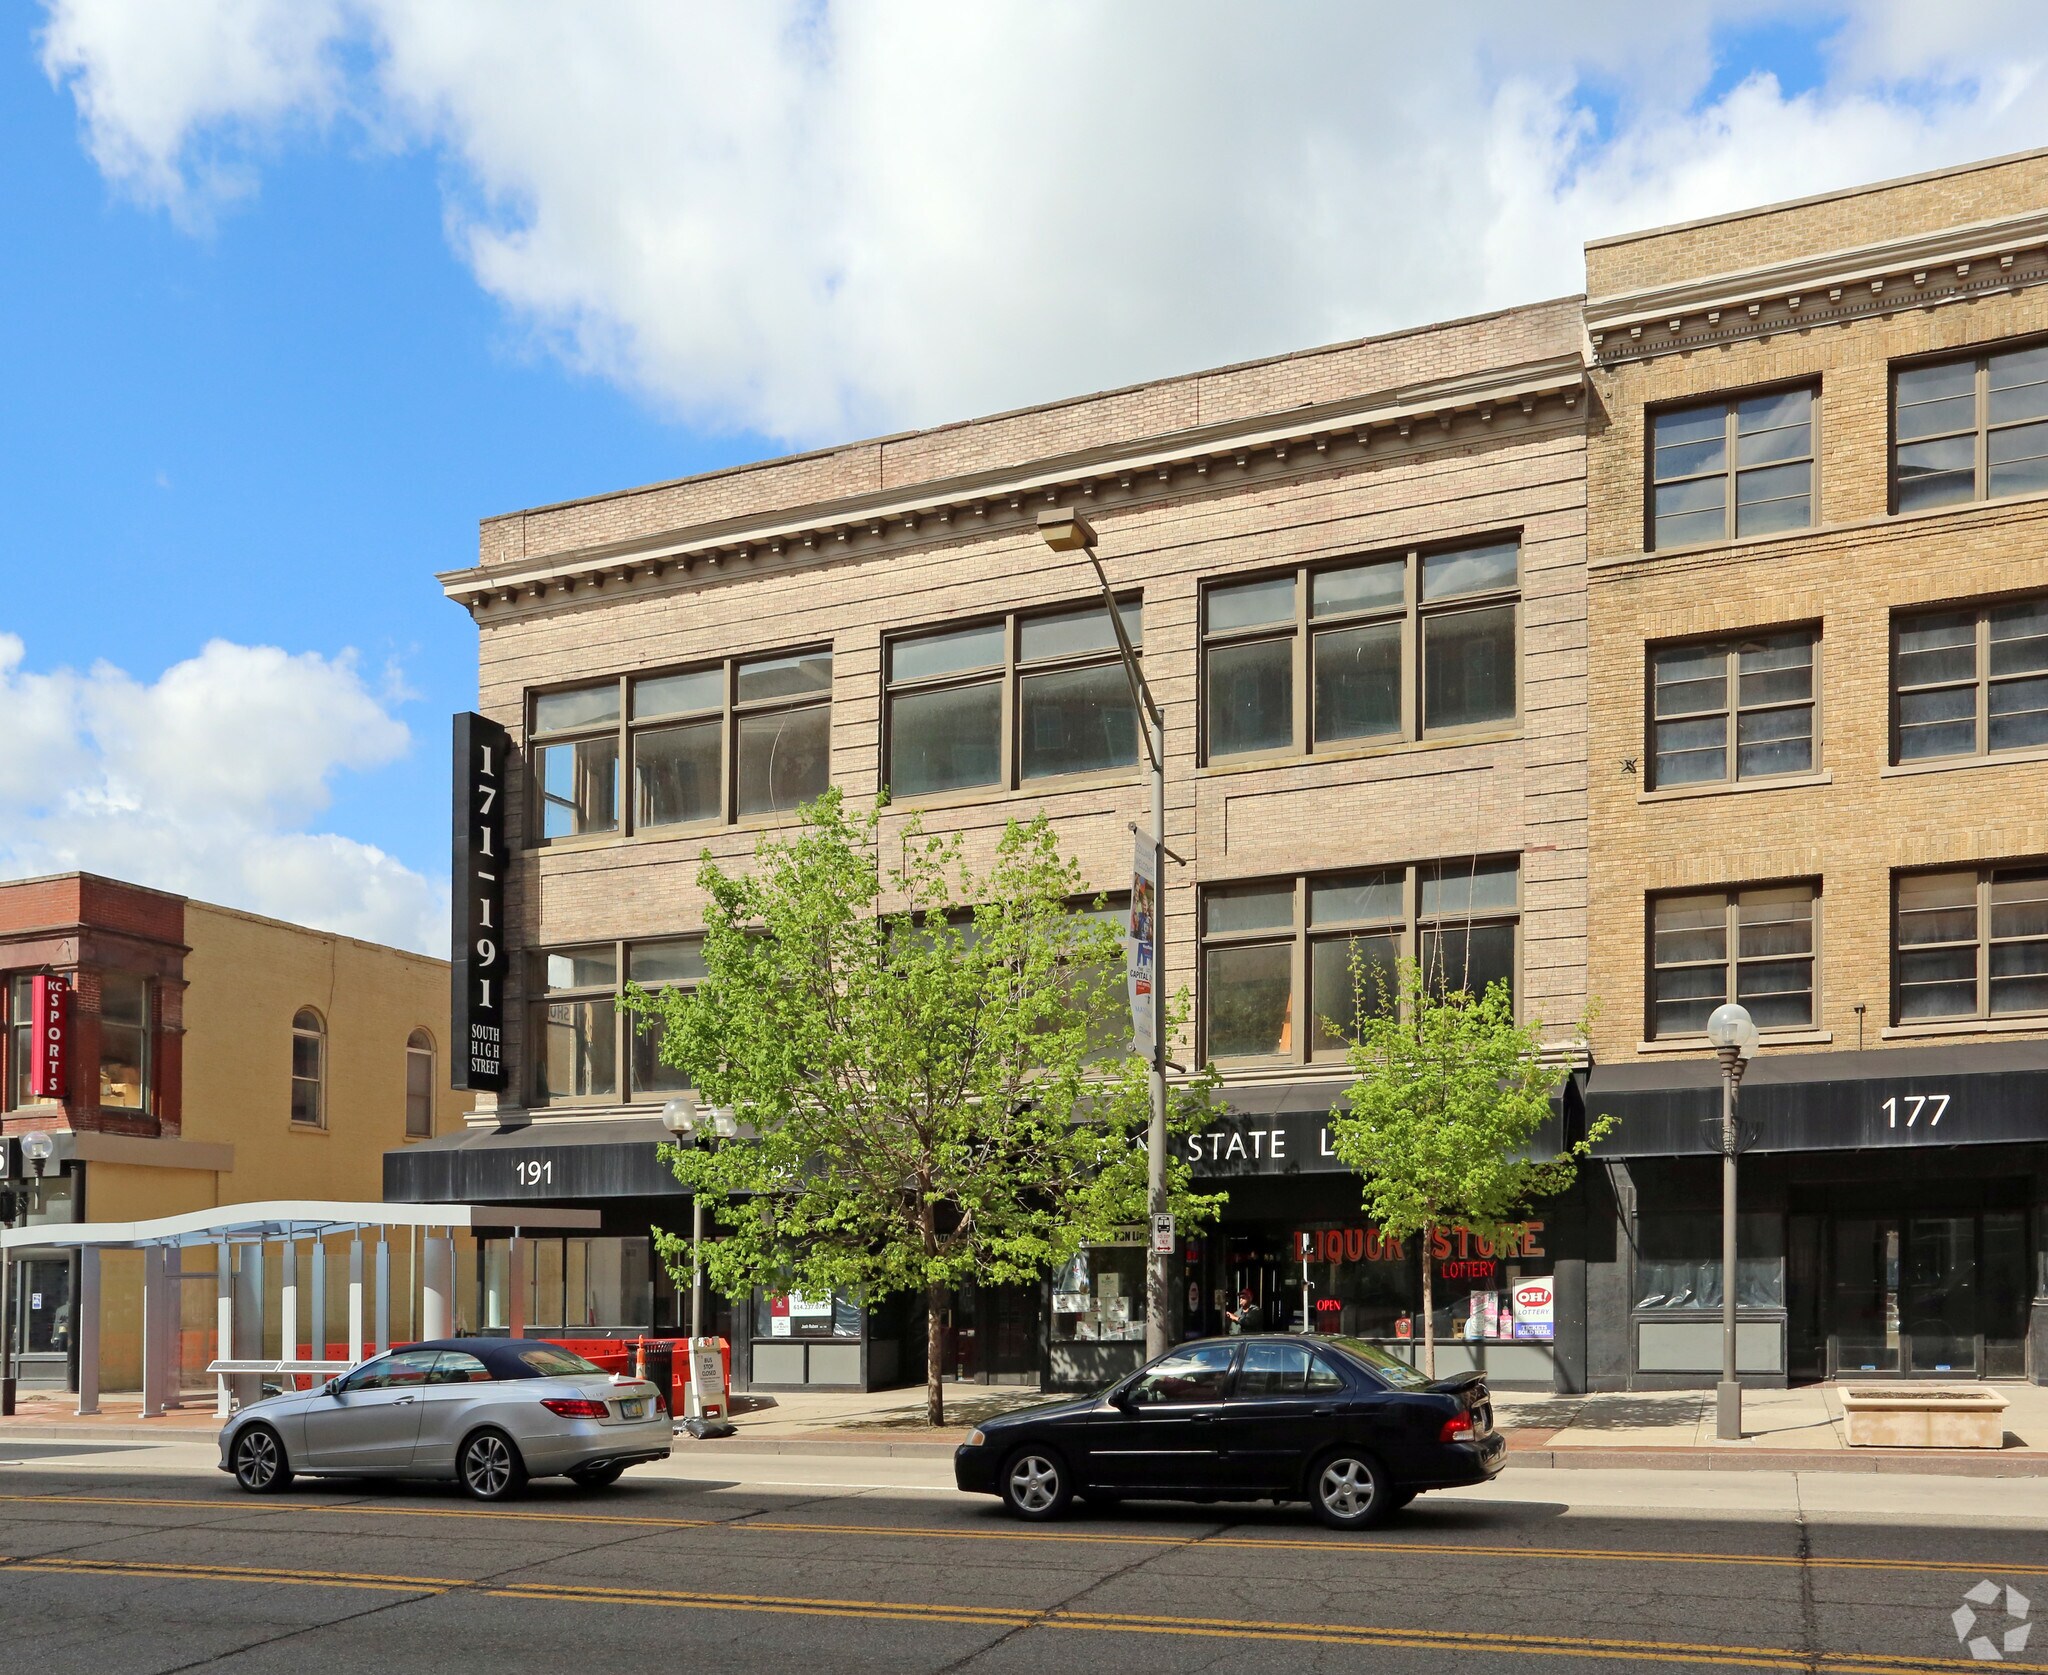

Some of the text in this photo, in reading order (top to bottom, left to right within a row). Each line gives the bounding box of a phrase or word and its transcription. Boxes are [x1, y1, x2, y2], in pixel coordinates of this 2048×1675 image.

[477, 745, 496, 1008] 171-191
[1129, 969, 1149, 980] CAPITAL
[47, 981, 63, 992] KC
[47, 993, 61, 1091] SPORTS
[471, 1023, 500, 1042] SOUTH
[471, 1040, 500, 1059] HIGH
[471, 1057, 500, 1075] STREET
[1882, 1094, 1951, 1128] 177
[1188, 1129, 1286, 1162] STATE
[516, 1160, 552, 1186] 191
[1294, 1222, 1545, 1265] LIQUOR STORE
[1442, 1261, 1496, 1278] LOTTERY
[1317, 1299, 1341, 1311] OPEN
[1518, 1291, 1549, 1303] OH!
